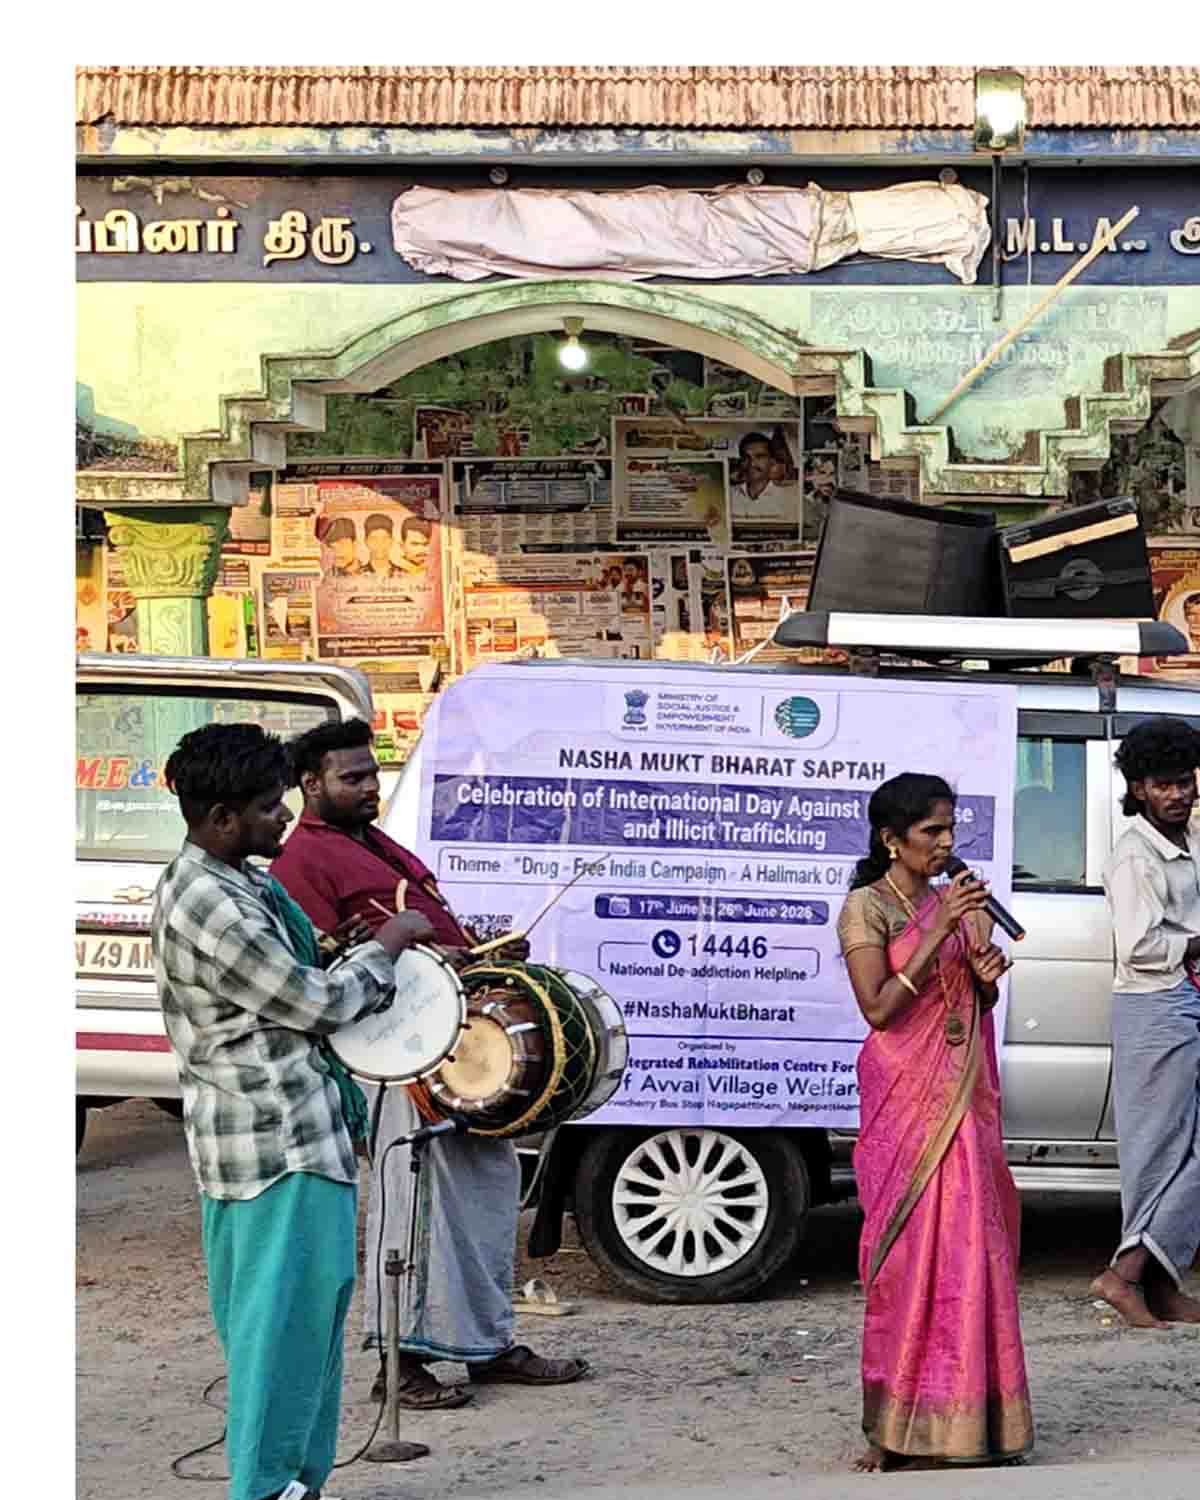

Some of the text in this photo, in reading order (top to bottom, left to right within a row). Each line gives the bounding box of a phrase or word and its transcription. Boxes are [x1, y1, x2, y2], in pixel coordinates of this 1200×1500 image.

[264, 210, 372, 266] திரு.
[657, 702, 691, 712] SOCIAL
[694, 703, 733, 714] JUSTICE
[559, 749, 886, 781] NASHA MUKT BHARAT SAPTAH
[457, 783, 576, 808] Celebration
[582, 786, 603, 808] of
[609, 788, 740, 813] International
[746, 794, 783, 820] Day
[788, 797, 861, 821] Against
[623, 819, 827, 850] and Illicit Trafficking
[573, 857, 605, 876] Free
[609, 858, 646, 878] India
[651, 861, 727, 884] Campaign
[741, 863, 754, 882] A
[757, 864, 822, 886] Hallmark
[825, 867, 843, 886] Of
[666, 902, 697, 917] June
[744, 904, 777, 920] June
[91, 941, 123, 969] 49
[687, 933, 769, 960] 14446
[609, 962, 664, 978] National
[754, 966, 808, 983] Helpline
[623, 1001, 796, 1023] #NashaMuktBharat
[627, 1056, 857, 1074] tegrated Rehabilitation Centre For
[623, 1074, 632, 1092] f
[640, 1075, 700, 1094] Avvai
[707, 1075, 779, 1099] Village
